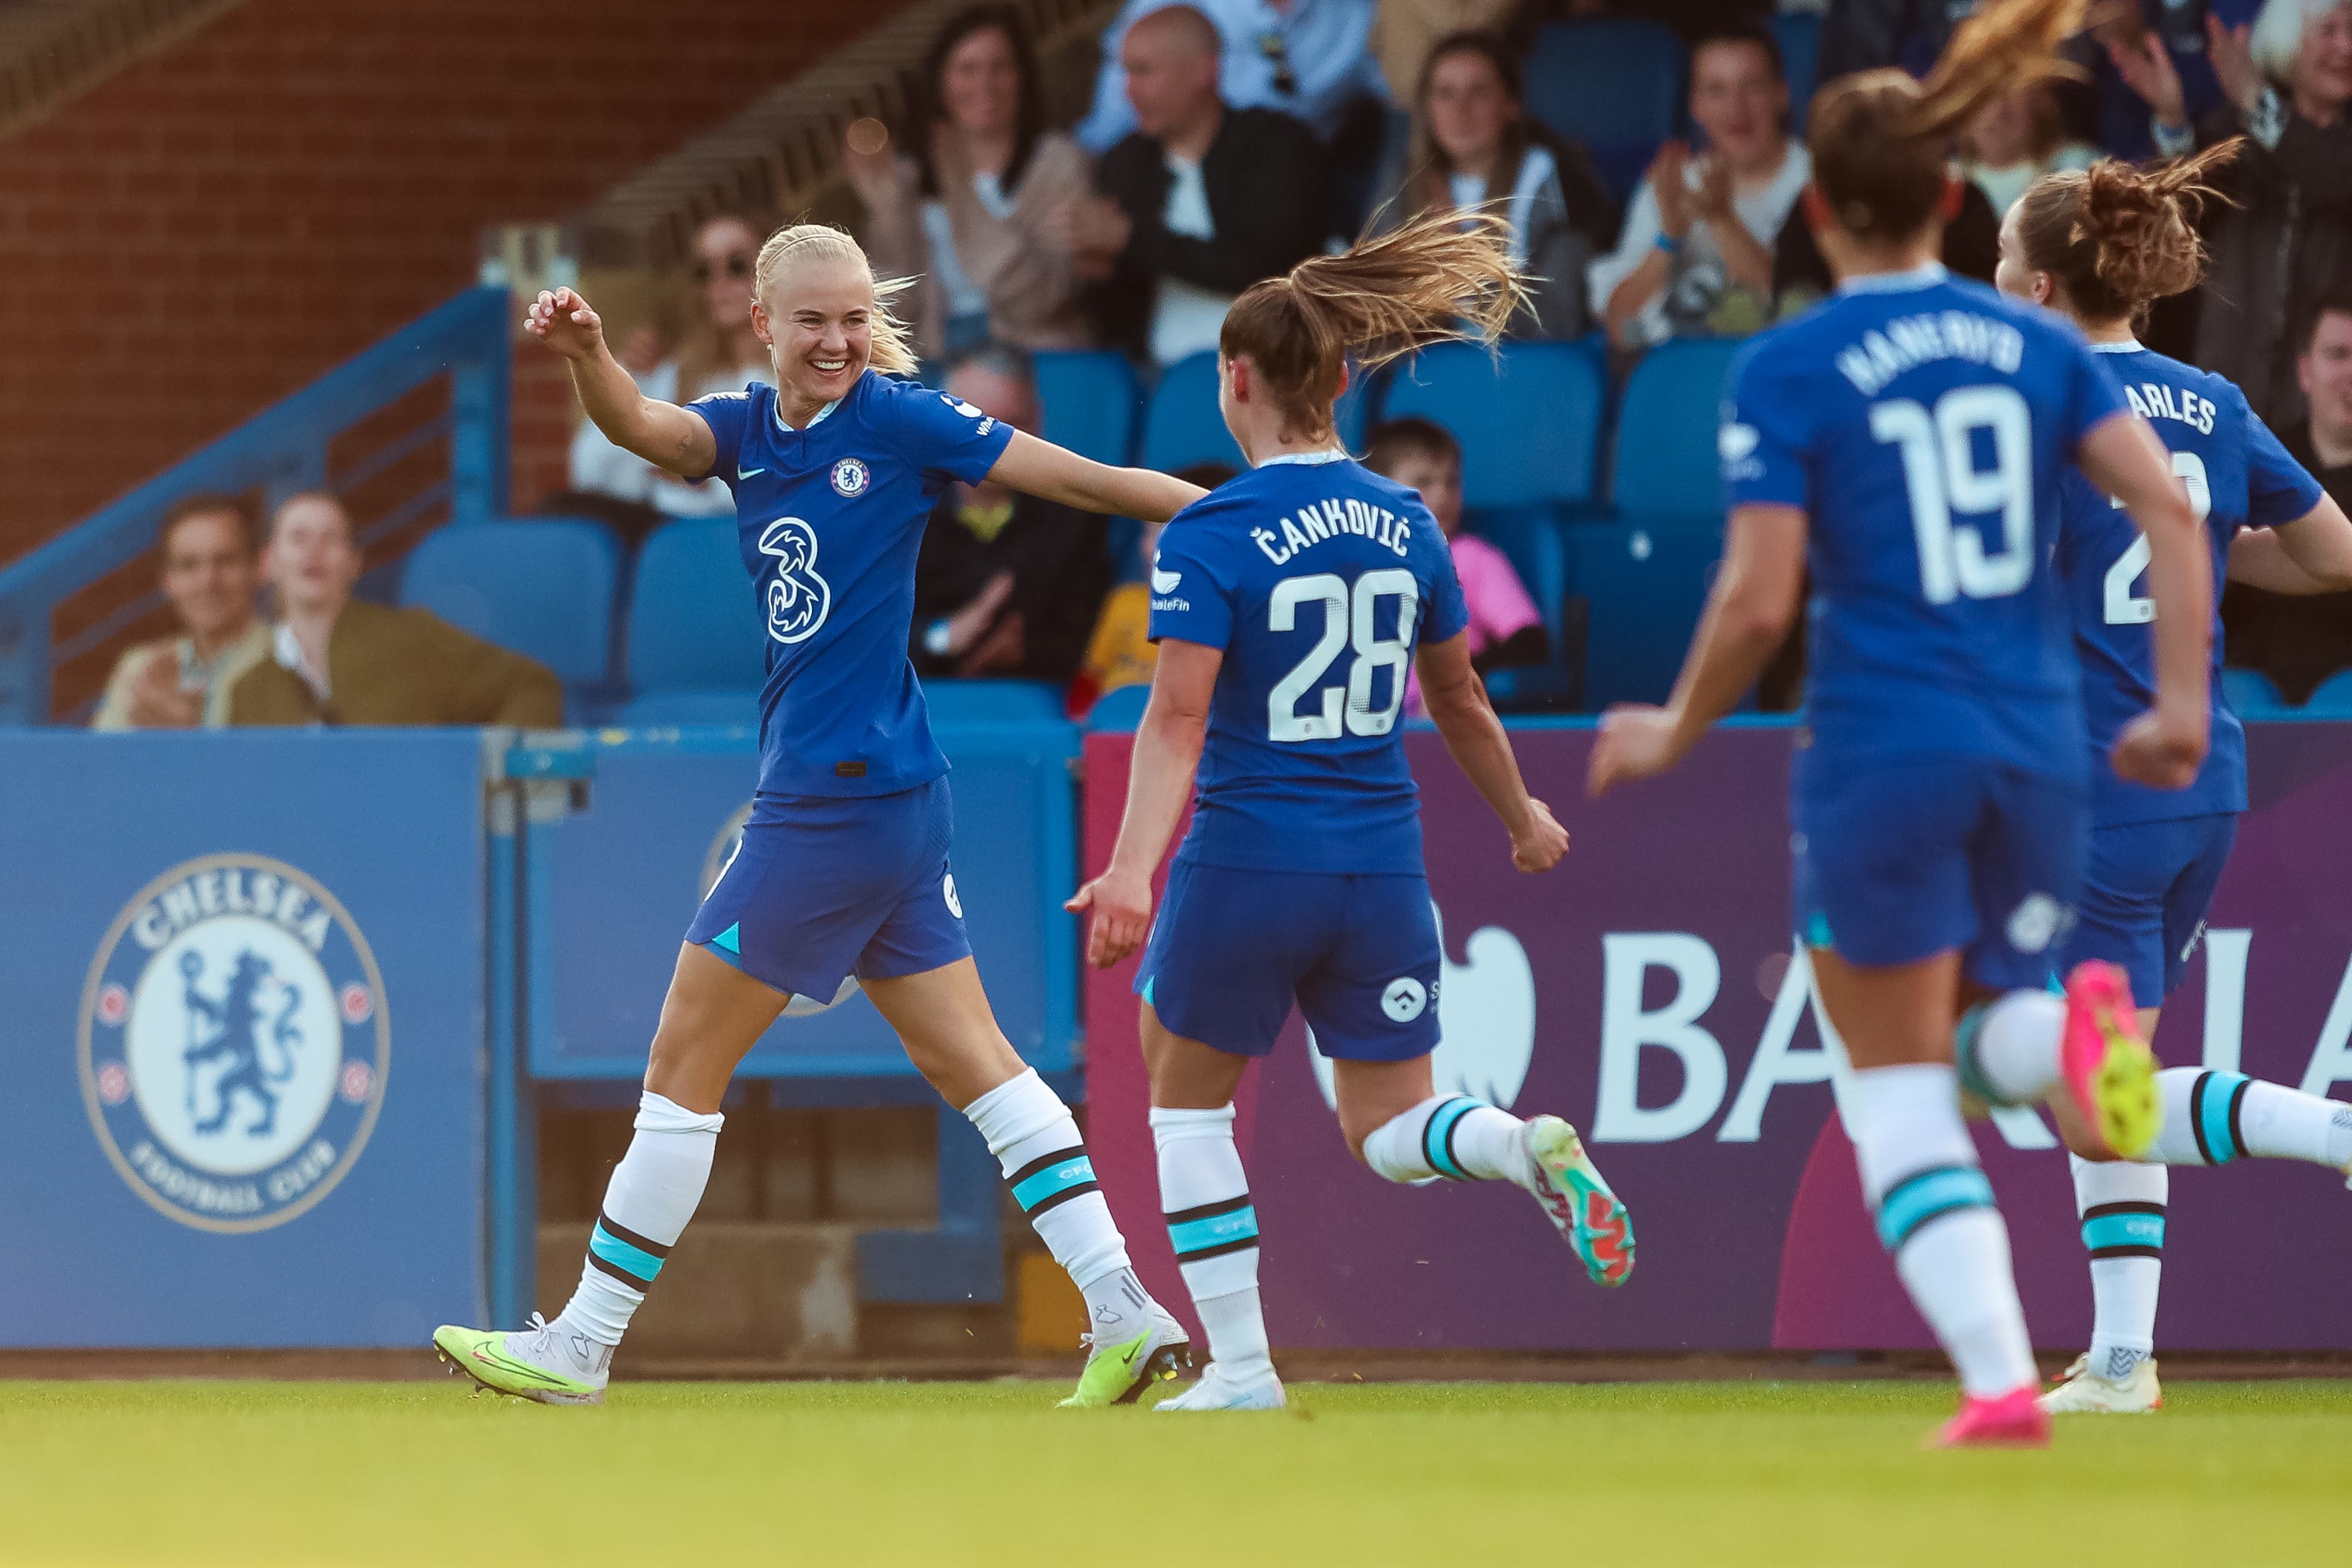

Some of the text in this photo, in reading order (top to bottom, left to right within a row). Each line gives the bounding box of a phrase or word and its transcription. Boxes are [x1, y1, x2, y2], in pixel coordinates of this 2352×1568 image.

[2124, 383, 2216, 435] ARLES
[1869, 383, 2035, 605] 19
[1267, 567, 1419, 742] 28
[132, 867, 332, 952] CHELSEA
